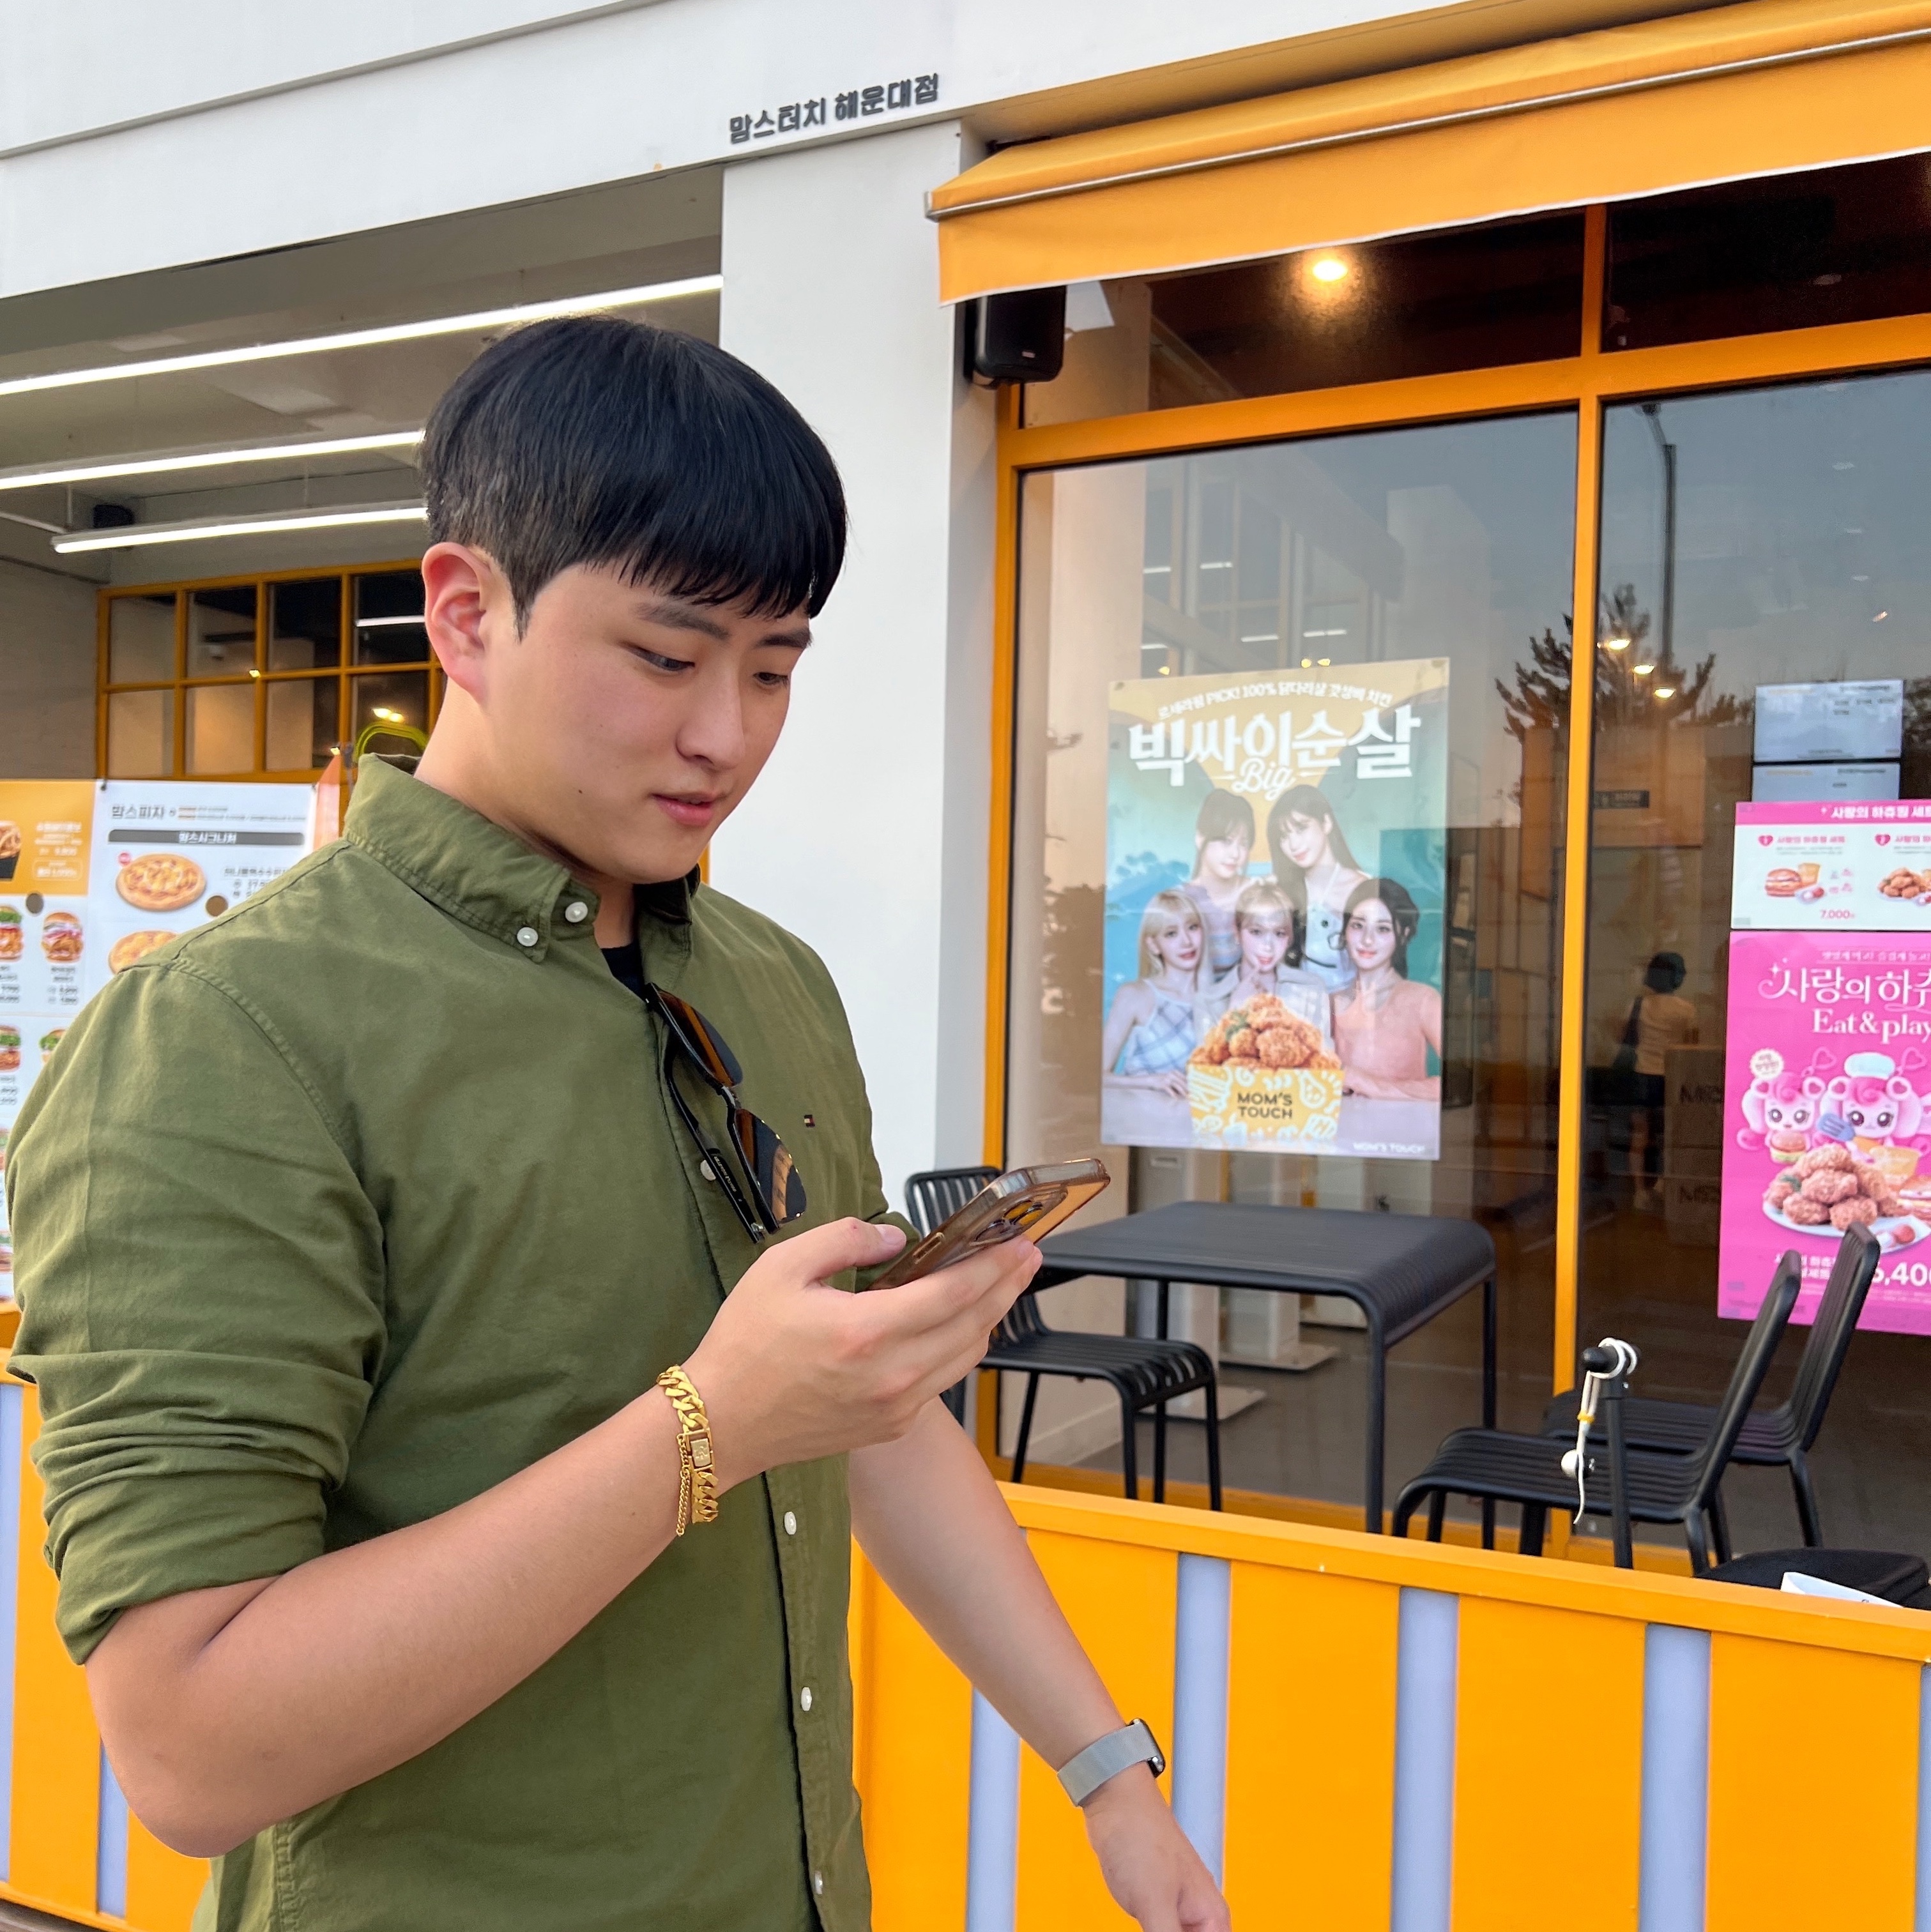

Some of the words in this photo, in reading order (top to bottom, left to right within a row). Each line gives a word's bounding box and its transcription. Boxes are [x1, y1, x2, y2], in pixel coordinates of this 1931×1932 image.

[730, 98, 827, 144] 맘스터치
[834, 73, 940, 121] 해운대점
[1242, 682, 1278, 699] 100%
[1128, 704, 1421, 787] 빅싸이순살
[1231, 757, 1296, 802] Big
[1758, 966, 1871, 1005] 사랑의
[1237, 1092, 1293, 1106] MOM'S
[1239, 1106, 1293, 1119] TOUCH
